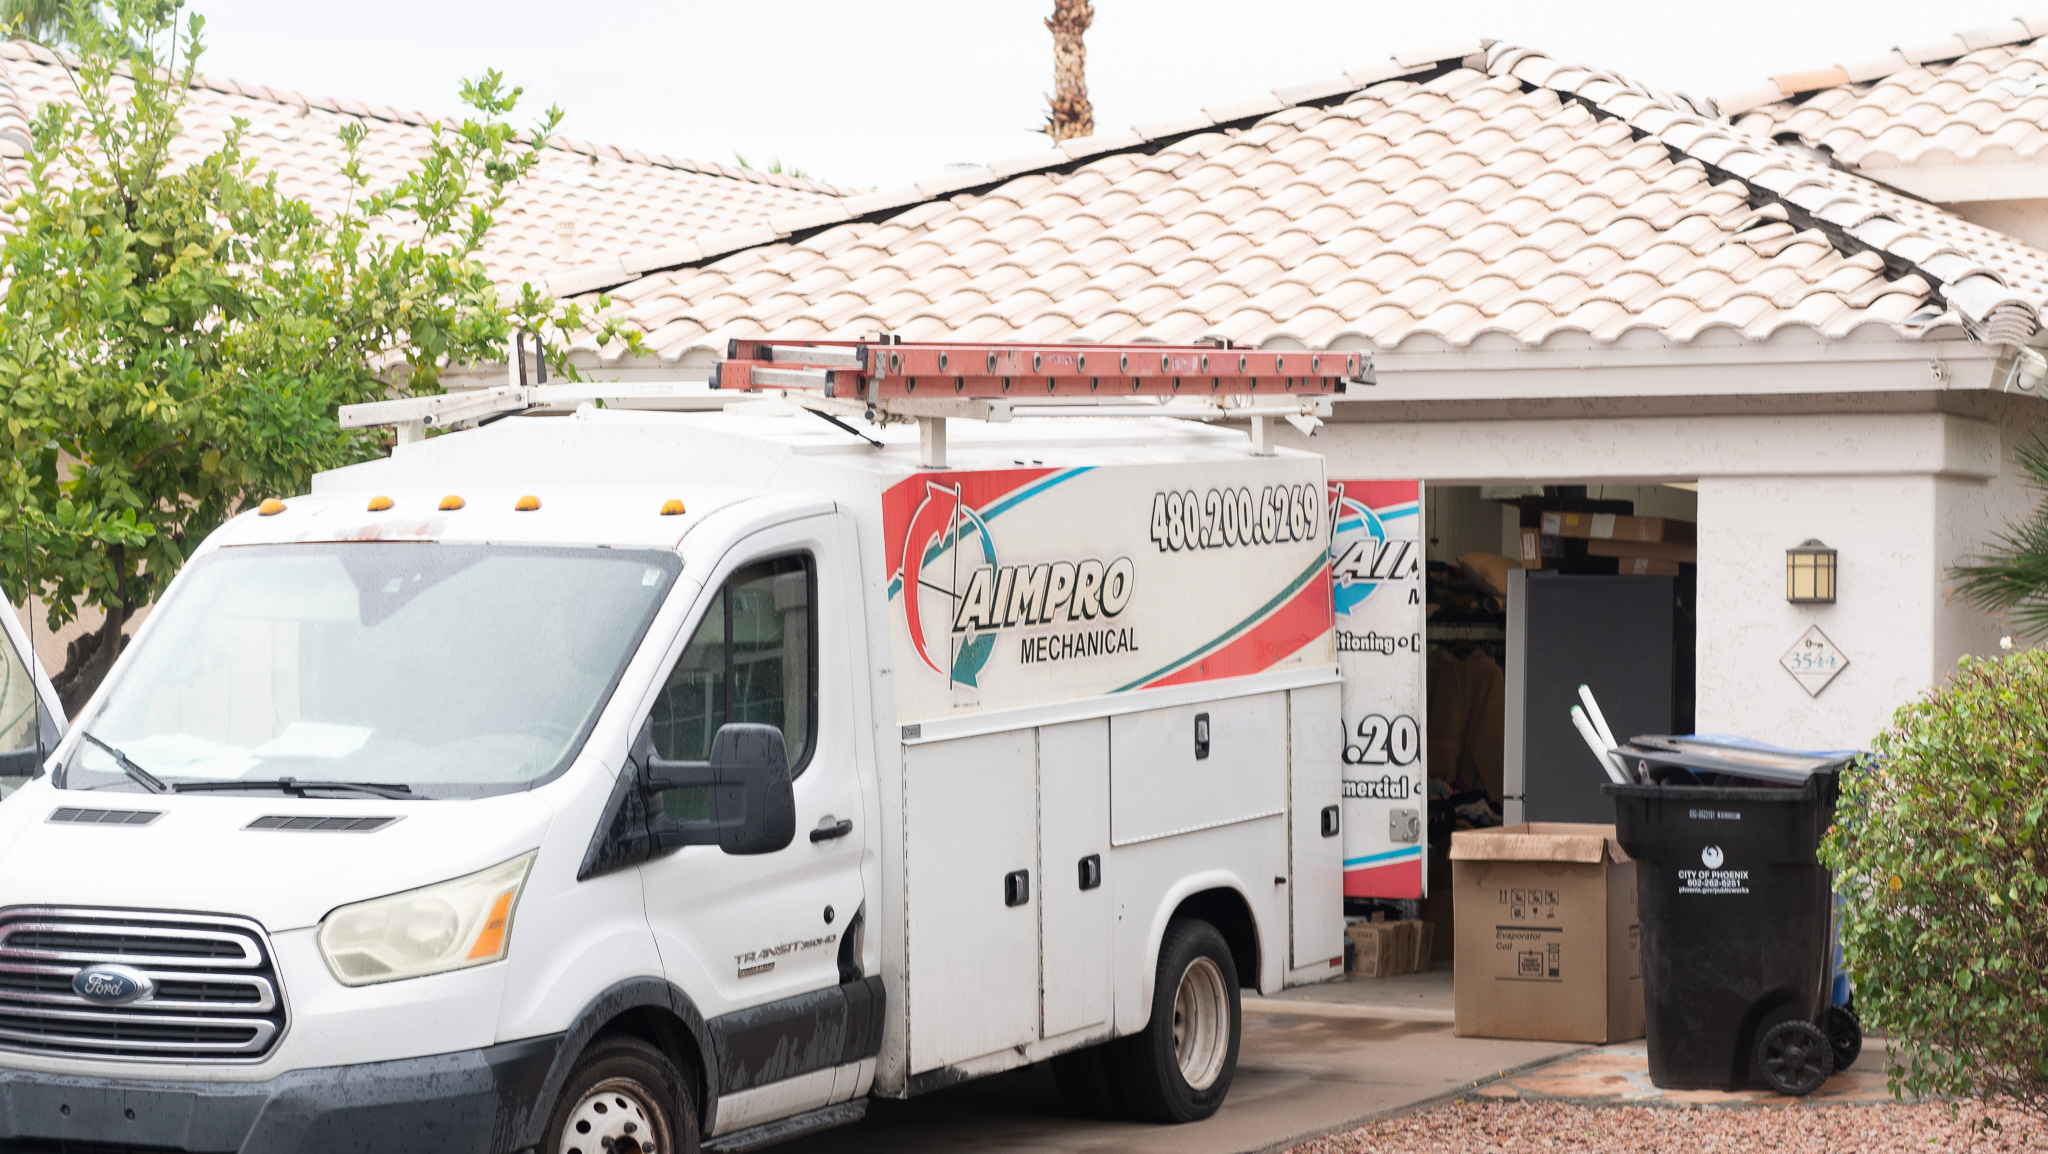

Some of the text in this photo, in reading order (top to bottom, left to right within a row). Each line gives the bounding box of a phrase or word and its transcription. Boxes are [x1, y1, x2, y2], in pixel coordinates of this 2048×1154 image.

[1150, 483, 1318, 552] 480.200.6269
[952, 556, 1134, 633] AIMPRO
[1021, 627, 1139, 664] MECHANICAL
[1678, 869, 1749, 880] CITY OF PHOENIX
[1496, 930, 1542, 941] Evaporator
[1496, 941, 1513, 951] Coil
[734, 940, 803, 965] TRANSIT
[84, 973, 123, 996] Ford
